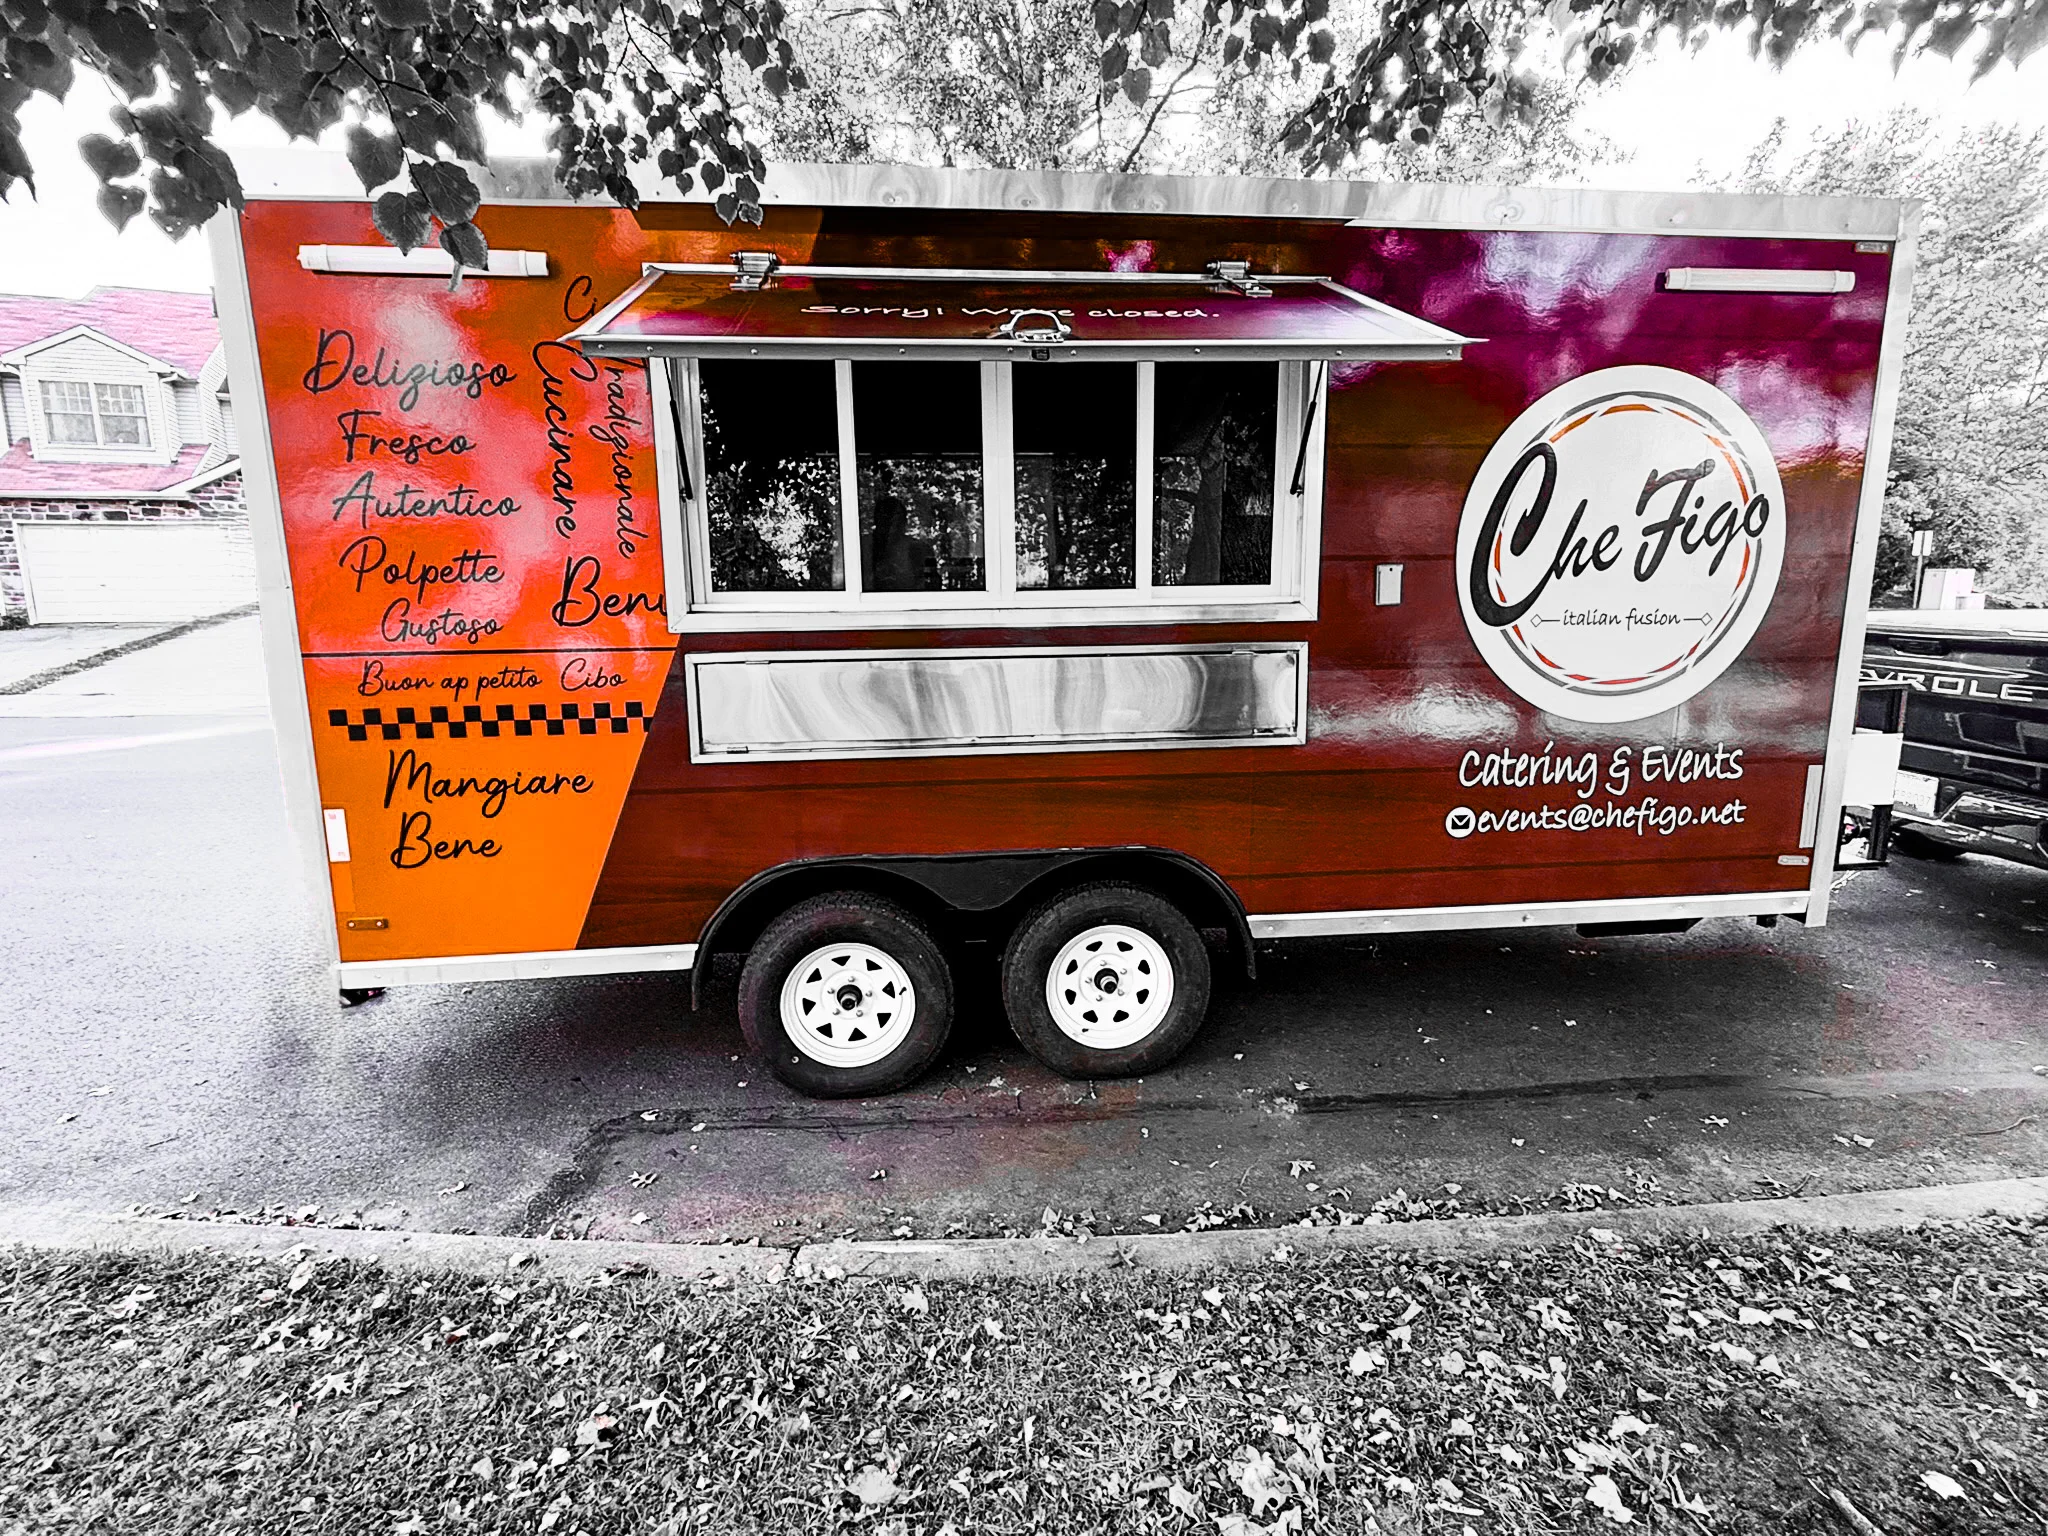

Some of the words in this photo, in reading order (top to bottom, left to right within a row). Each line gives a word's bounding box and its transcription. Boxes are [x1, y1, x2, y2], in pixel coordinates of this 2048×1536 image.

[1088, 307, 1220, 318] closed.
[303, 328, 516, 412] Delizioso
[337, 409, 476, 465] Fresco
[532, 341, 598, 539] Cucinare
[332, 470, 521, 529] Autentico
[1469, 442, 1623, 628] Che
[1633, 458, 1770, 583] Figo
[339, 535, 505, 603] Polpette
[381, 597, 504, 645] Gustoso
[1562, 608, 1622, 627] italian
[1625, 607, 1681, 631] fusion
[357, 659, 436, 697] Buon
[560, 657, 628, 692] Cibo
[383, 749, 594, 819] Mangiare
[1459, 741, 1599, 798] Catering
[1605, 745, 1632, 796] &
[1642, 741, 1744, 783] Events
[390, 811, 502, 869] Bene
[1477, 797, 1747, 836] events@chefigo.net
